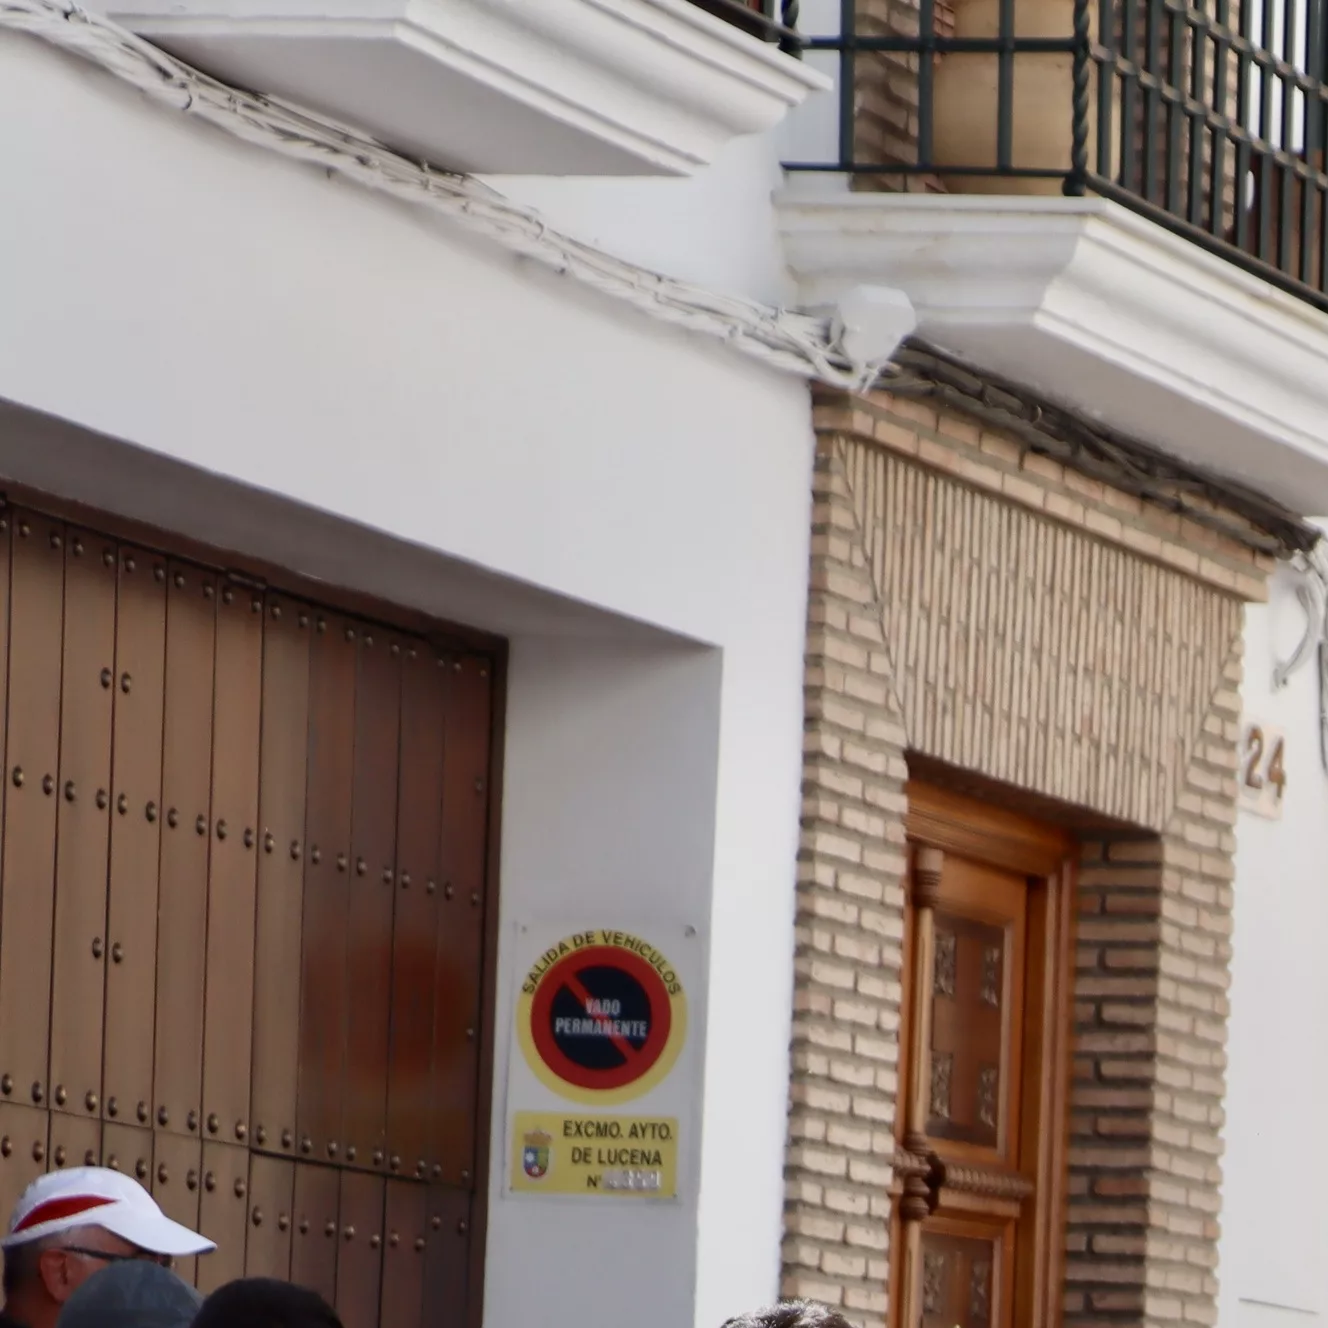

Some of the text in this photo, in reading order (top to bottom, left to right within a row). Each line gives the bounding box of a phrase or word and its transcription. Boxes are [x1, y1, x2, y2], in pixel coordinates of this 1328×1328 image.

[1245, 725, 1286, 799] 24
[522, 929, 682, 996] SALIDA DE VEHICULOS
[585, 997, 622, 1016] VADO
[555, 1017, 648, 1038] PERMANENTE
[563, 1119, 673, 1141] EXCMO. AYTO.
[571, 1147, 663, 1167] DE LUCENA
